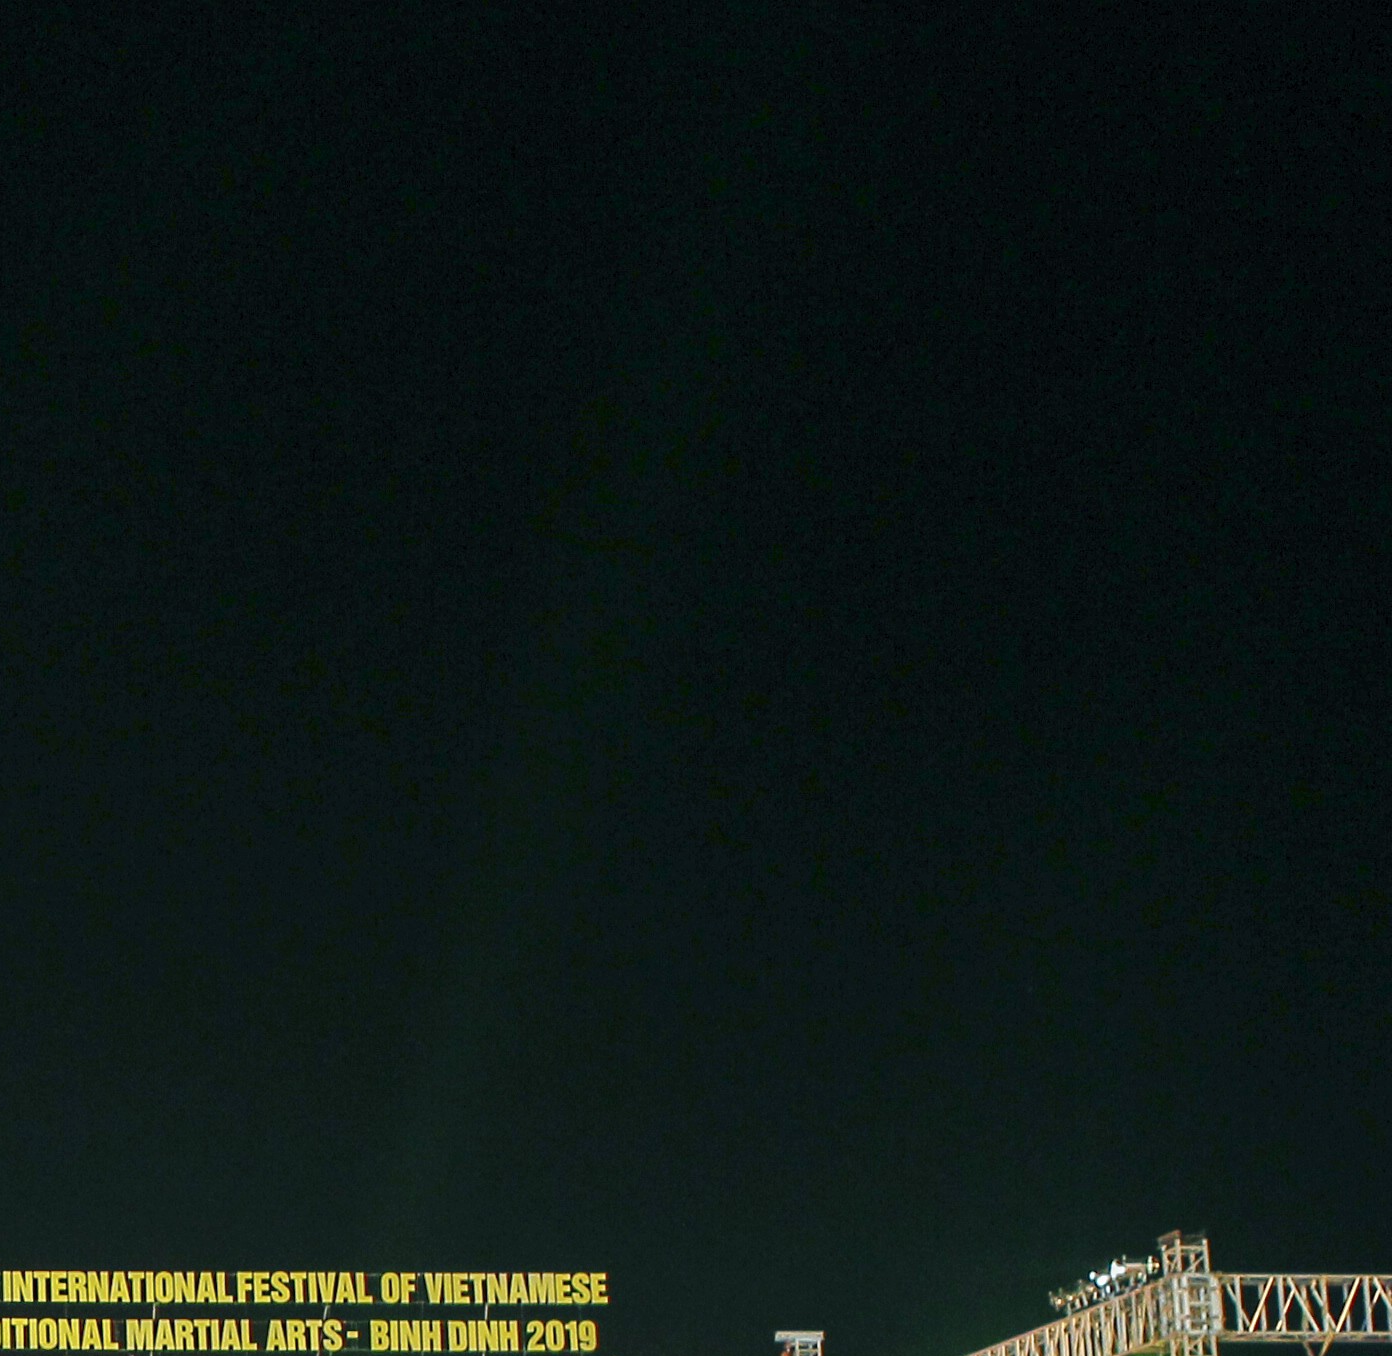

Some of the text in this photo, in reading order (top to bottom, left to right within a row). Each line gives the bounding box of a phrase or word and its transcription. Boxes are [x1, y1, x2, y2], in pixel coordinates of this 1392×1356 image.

[3, 1271, 233, 1303] INTERNATIONAL
[237, 1271, 373, 1303] FESTIVAL
[381, 1272, 416, 1304] OF
[424, 1272, 609, 1304] VIETNAMESE
[126, 1319, 258, 1351] MARTIAL
[370, 1320, 442, 1352] BINH
[448, 1320, 520, 1352] DINH
[527, 1320, 597, 1352] 2019
